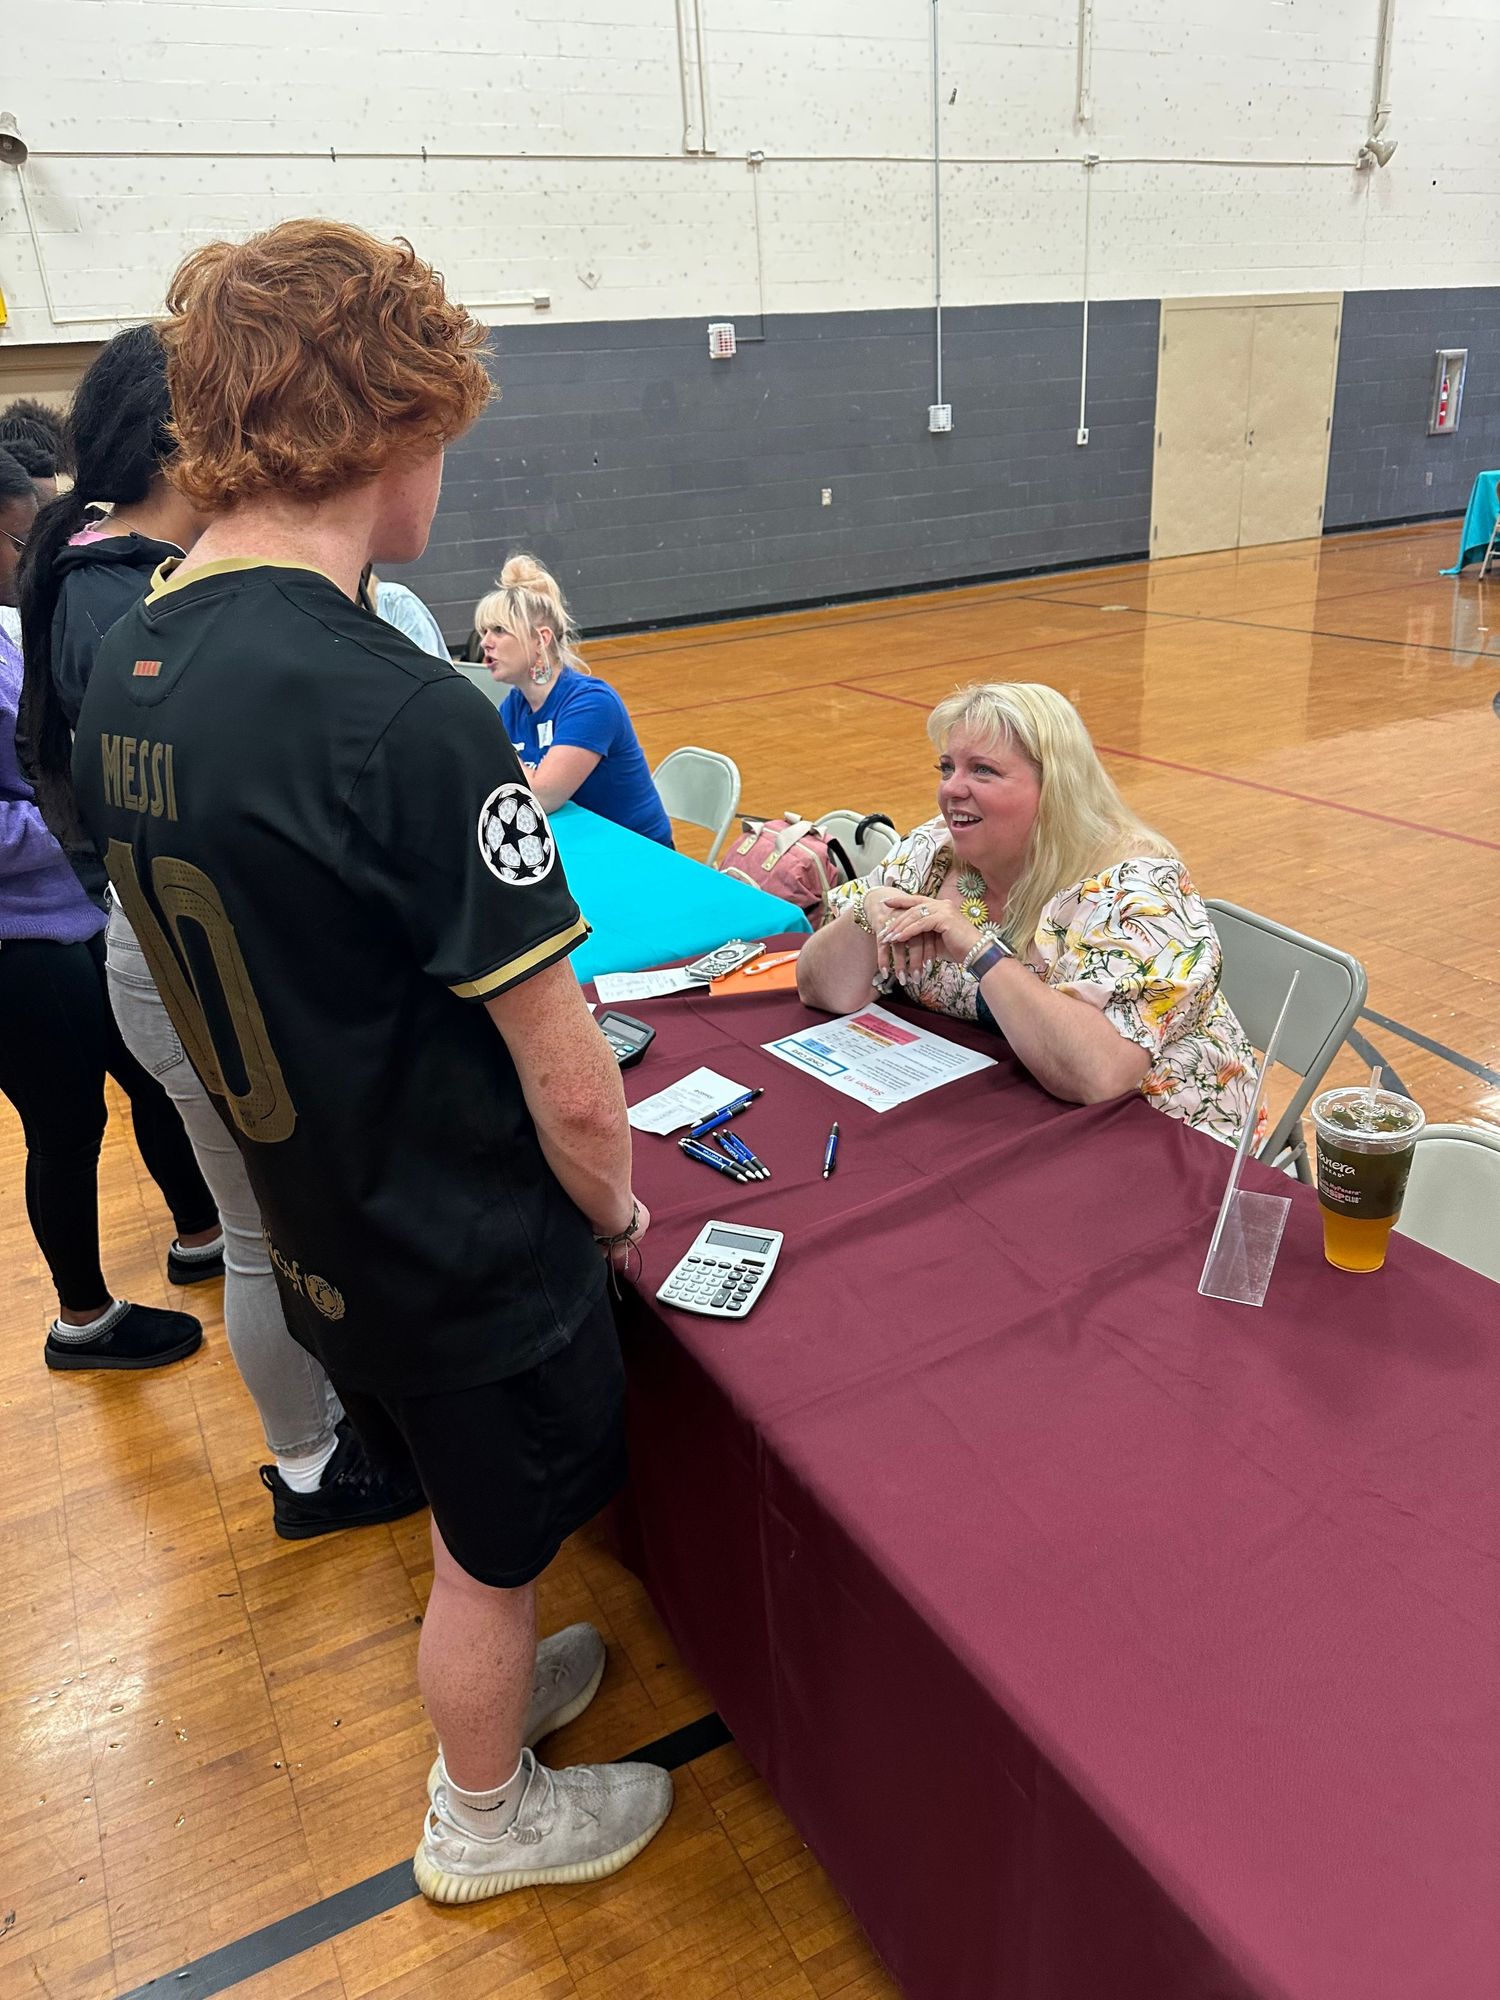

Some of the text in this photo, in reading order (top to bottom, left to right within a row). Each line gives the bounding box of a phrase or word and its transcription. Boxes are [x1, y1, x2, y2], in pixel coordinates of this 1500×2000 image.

[101, 733, 178, 822] MESSI
[103, 838, 298, 1143] 10
[791, 1049, 805, 1058] Card
[856, 1080, 884, 1096] Station
